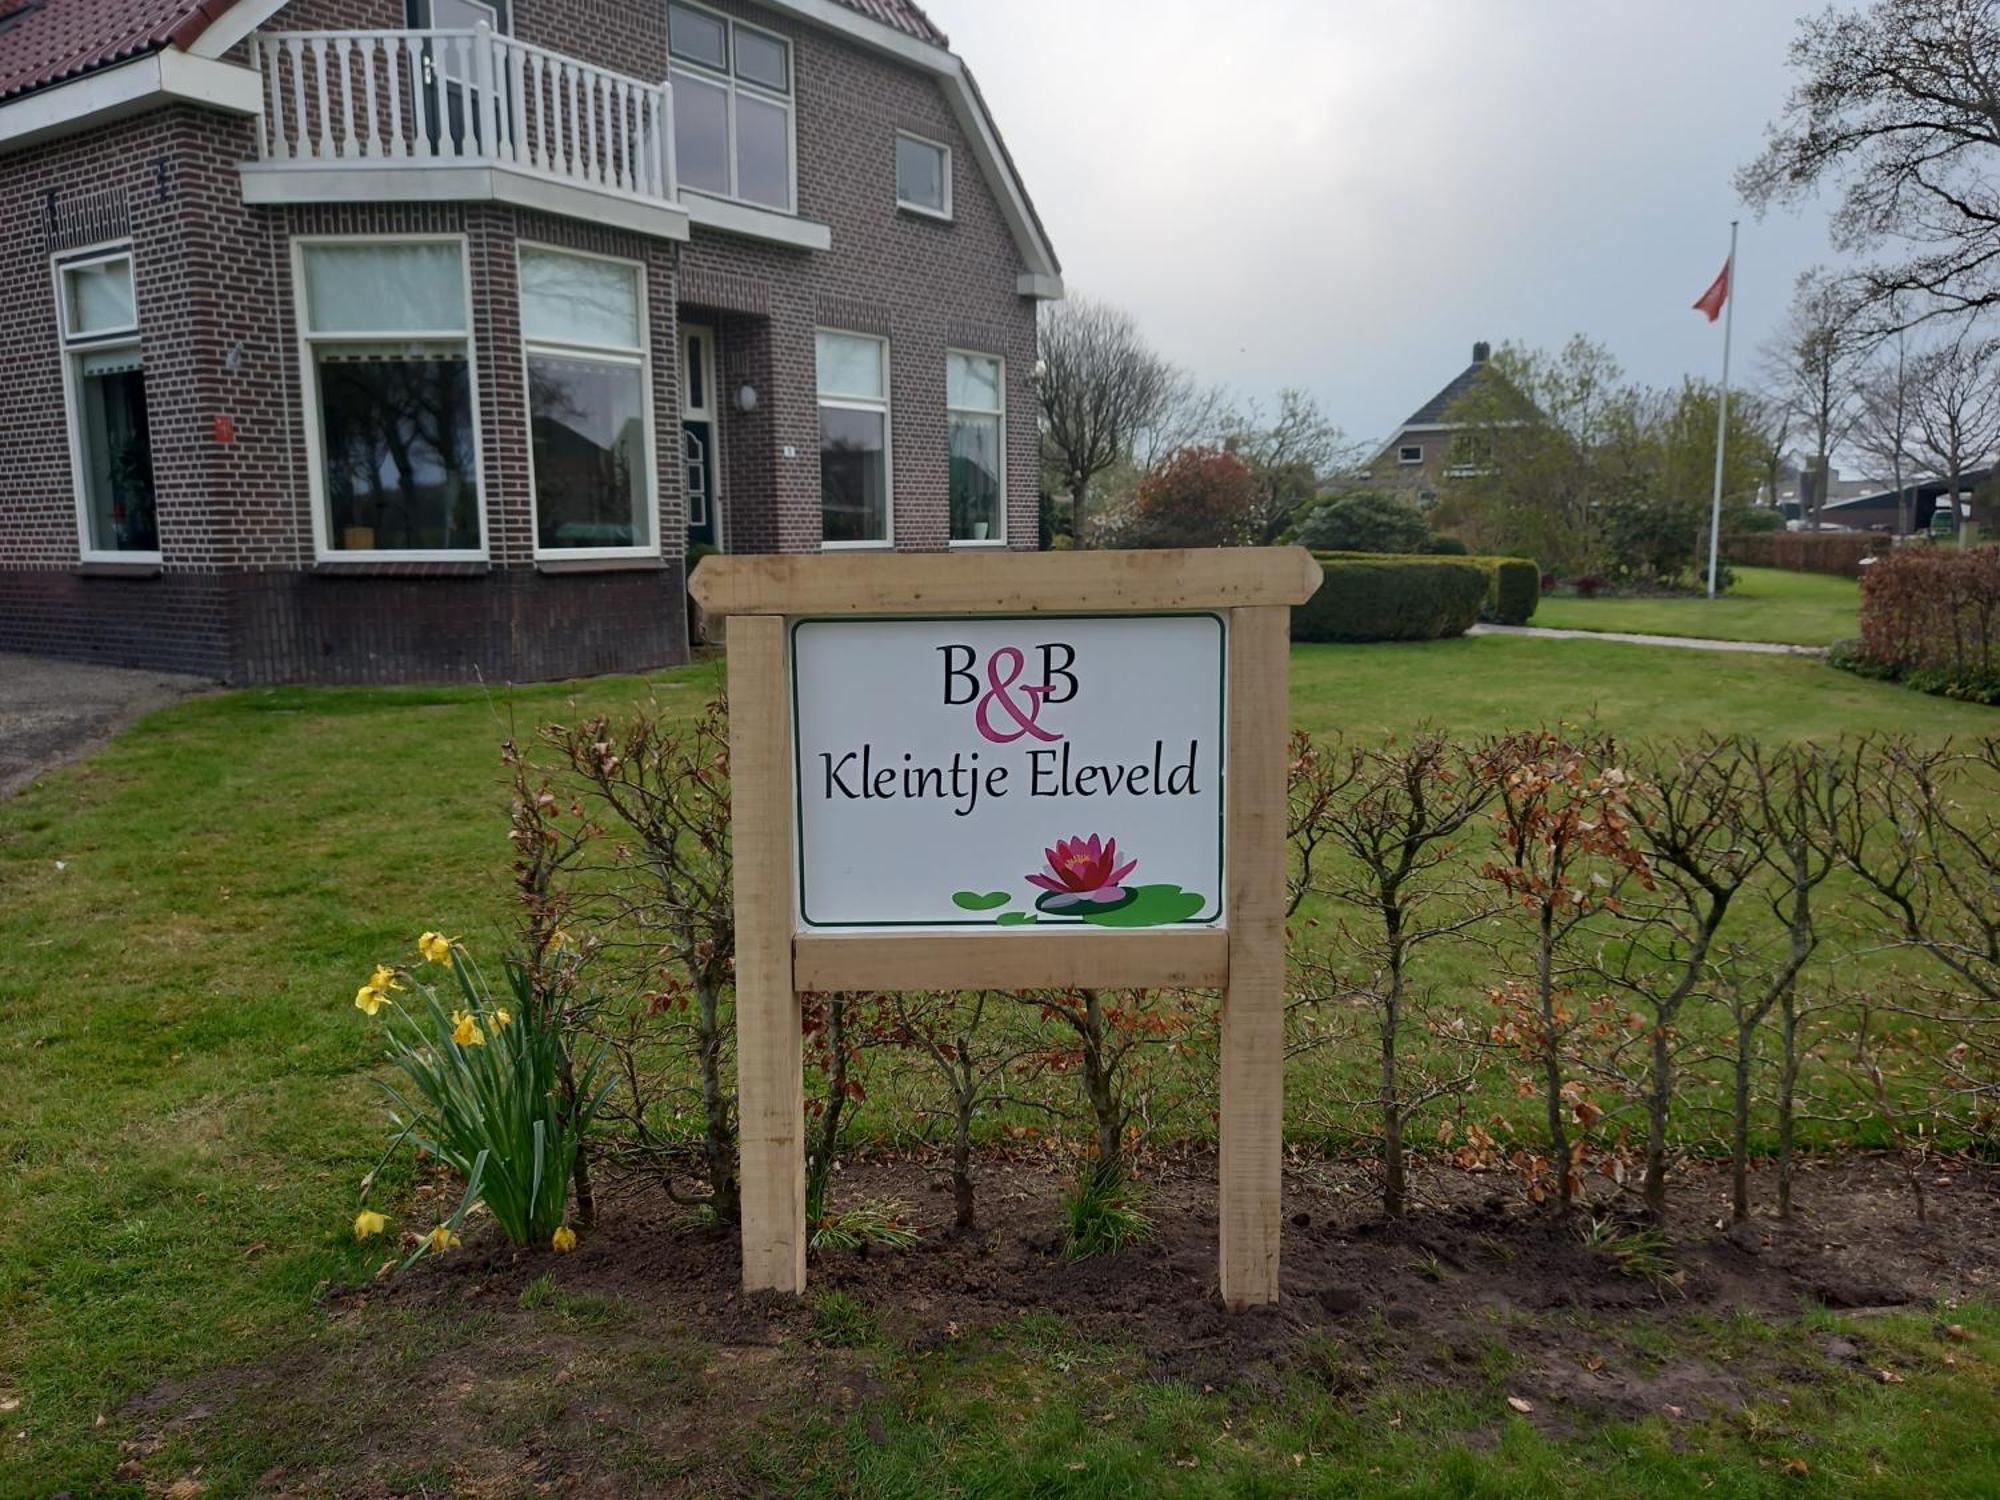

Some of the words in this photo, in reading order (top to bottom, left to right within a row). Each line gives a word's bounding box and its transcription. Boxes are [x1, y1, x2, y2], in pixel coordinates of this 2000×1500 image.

[936, 643, 1079, 744] B&B
[819, 743, 1009, 816] Kleintje
[1026, 739, 1201, 797] Eleveld
